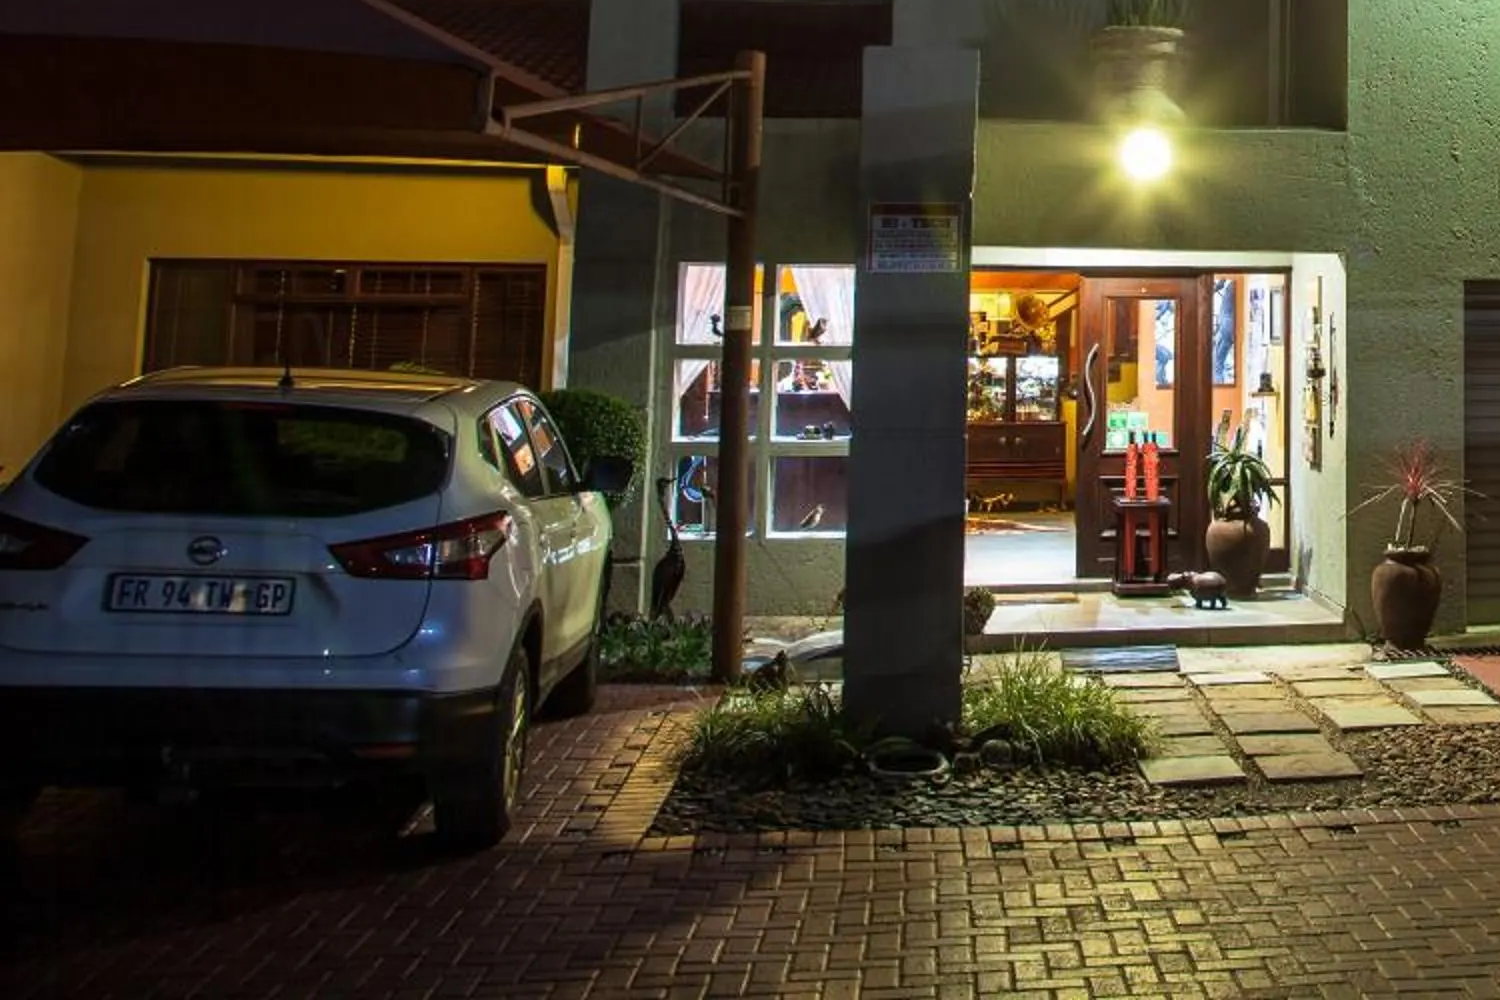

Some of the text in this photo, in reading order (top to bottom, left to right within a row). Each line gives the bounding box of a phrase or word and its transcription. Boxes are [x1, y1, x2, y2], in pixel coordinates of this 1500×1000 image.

[117, 579, 150, 607] FR
[162, 580, 191, 608] 94
[255, 582, 286, 609] GP
